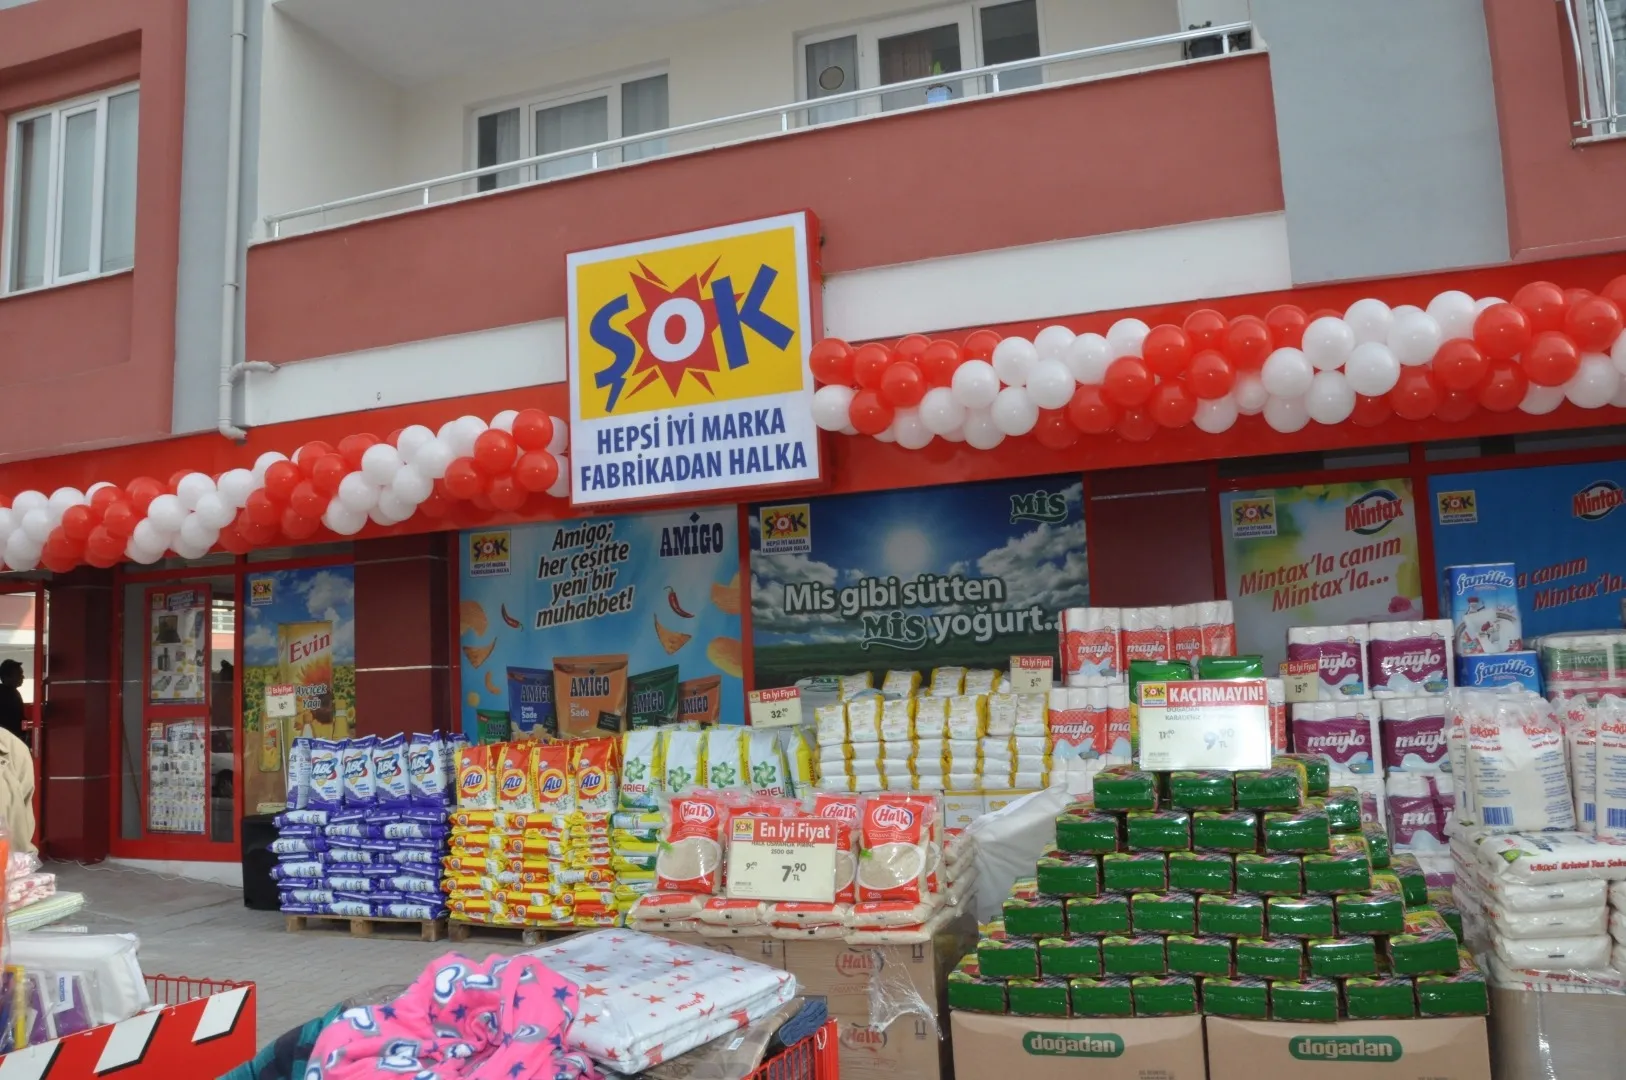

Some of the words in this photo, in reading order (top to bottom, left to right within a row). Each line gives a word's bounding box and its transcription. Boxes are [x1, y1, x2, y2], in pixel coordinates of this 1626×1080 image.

[589, 263, 795, 413] ŞOK
[597, 416, 660, 455] HEPSİ
[667, 411, 694, 449] İYİ
[701, 407, 786, 443] MARKA
[581, 453, 722, 491] FABRİKADAN
[729, 441, 807, 476] HALKA
[1345, 491, 1404, 532] Mintax
[1572, 487, 1626, 518] Mintax
[552, 521, 613, 551] Amigo;
[538, 555, 565, 578] her
[571, 542, 630, 573] çeşitte
[1239, 551, 1335, 597] Mintax'la
[1339, 537, 1402, 566] canım
[1531, 558, 1588, 586] canım
[552, 575, 588, 605] yeni
[590, 569, 617, 592] bir
[1457, 570, 1515, 597] familia
[785, 580, 835, 612] Mis
[840, 577, 897, 616] gibi
[903, 575, 1003, 604] sütten
[536, 588, 634, 627] muhabbet!
[289, 633, 332, 664] Evin
[1078, 643, 1115, 657] maylo
[1127, 642, 1165, 657] maylo
[1175, 639, 1200, 654] maylo
[1319, 652, 1357, 676] aylo
[1382, 649, 1441, 673] maylo
[1475, 659, 1536, 686] familia
[763, 691, 771, 700] En
[781, 689, 797, 699] Fiyat
[1169, 686, 1264, 706] KAÇIRMAYIN!
[521, 711, 538, 719] Sade
[570, 708, 590, 717] Sade
[1051, 720, 1094, 740] maylo
[1307, 729, 1366, 753] maylo
[313, 762, 335, 775] ABC
[345, 759, 366, 774] ABC
[377, 760, 398, 774] ABC
[462, 774, 482, 788] ALO
[502, 776, 522, 790] ALO
[543, 777, 562, 793] ALO
[580, 774, 600, 789] ALO
[622, 784, 648, 793] ARIEL
[684, 802, 711, 819] Halk
[828, 803, 857, 819] Halk
[878, 808, 909, 825] Halk
[760, 822, 776, 838] En
[779, 820, 795, 841] İyi
[798, 822, 831, 842] Fiyat
[1031, 1036, 1116, 1055] doğadan
[1298, 1038, 1393, 1058] doğadan
